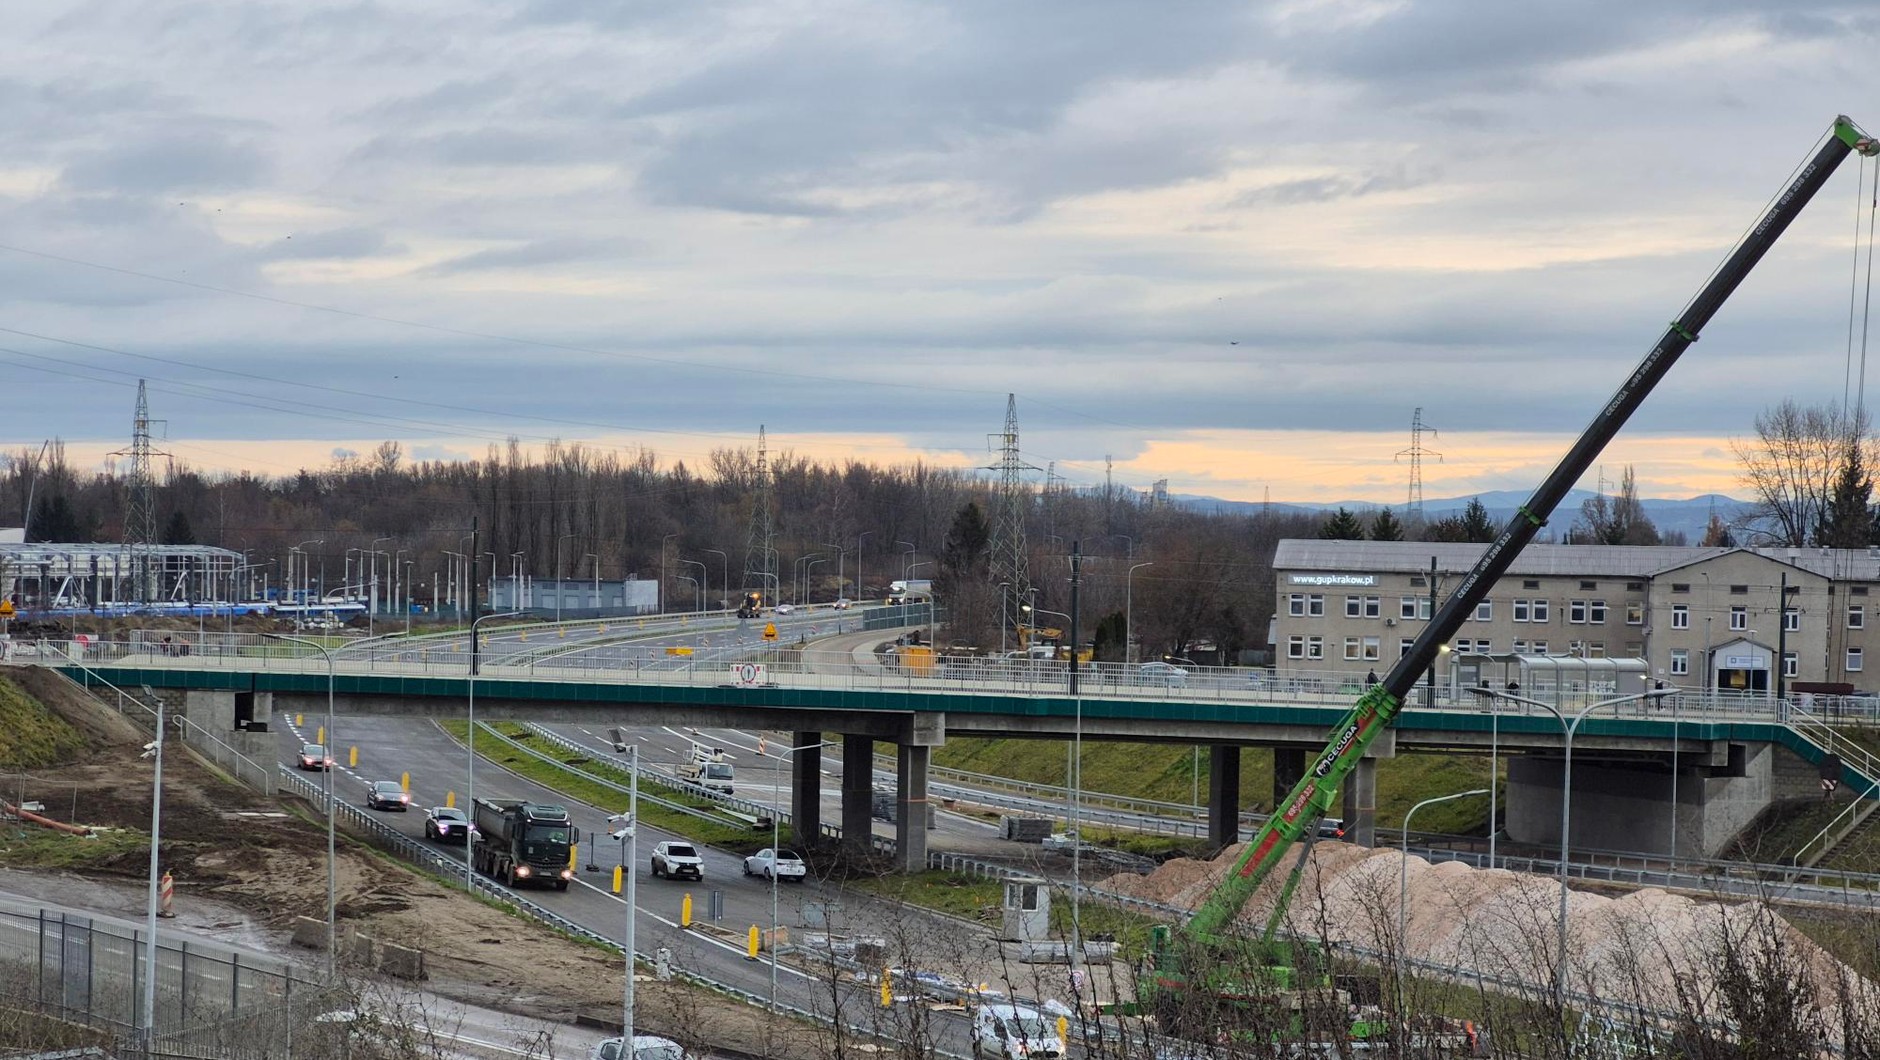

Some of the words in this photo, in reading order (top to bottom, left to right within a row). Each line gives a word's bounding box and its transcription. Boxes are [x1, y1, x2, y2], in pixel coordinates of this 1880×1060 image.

[1756, 208, 1779, 235] CECUGA
[1780, 191, 1794, 205] 695
[1792, 178, 1805, 192] 298
[1803, 163, 1817, 179] 332
[1605, 390, 1629, 417] CECUGA
[1651, 347, 1664, 361] 332
[1293, 575, 1374, 586] www.gupkrakow.pl
[1457, 573, 1479, 599] CECUGA
[1499, 532, 1512, 546] 332
[1327, 725, 1358, 762] CECUGA
